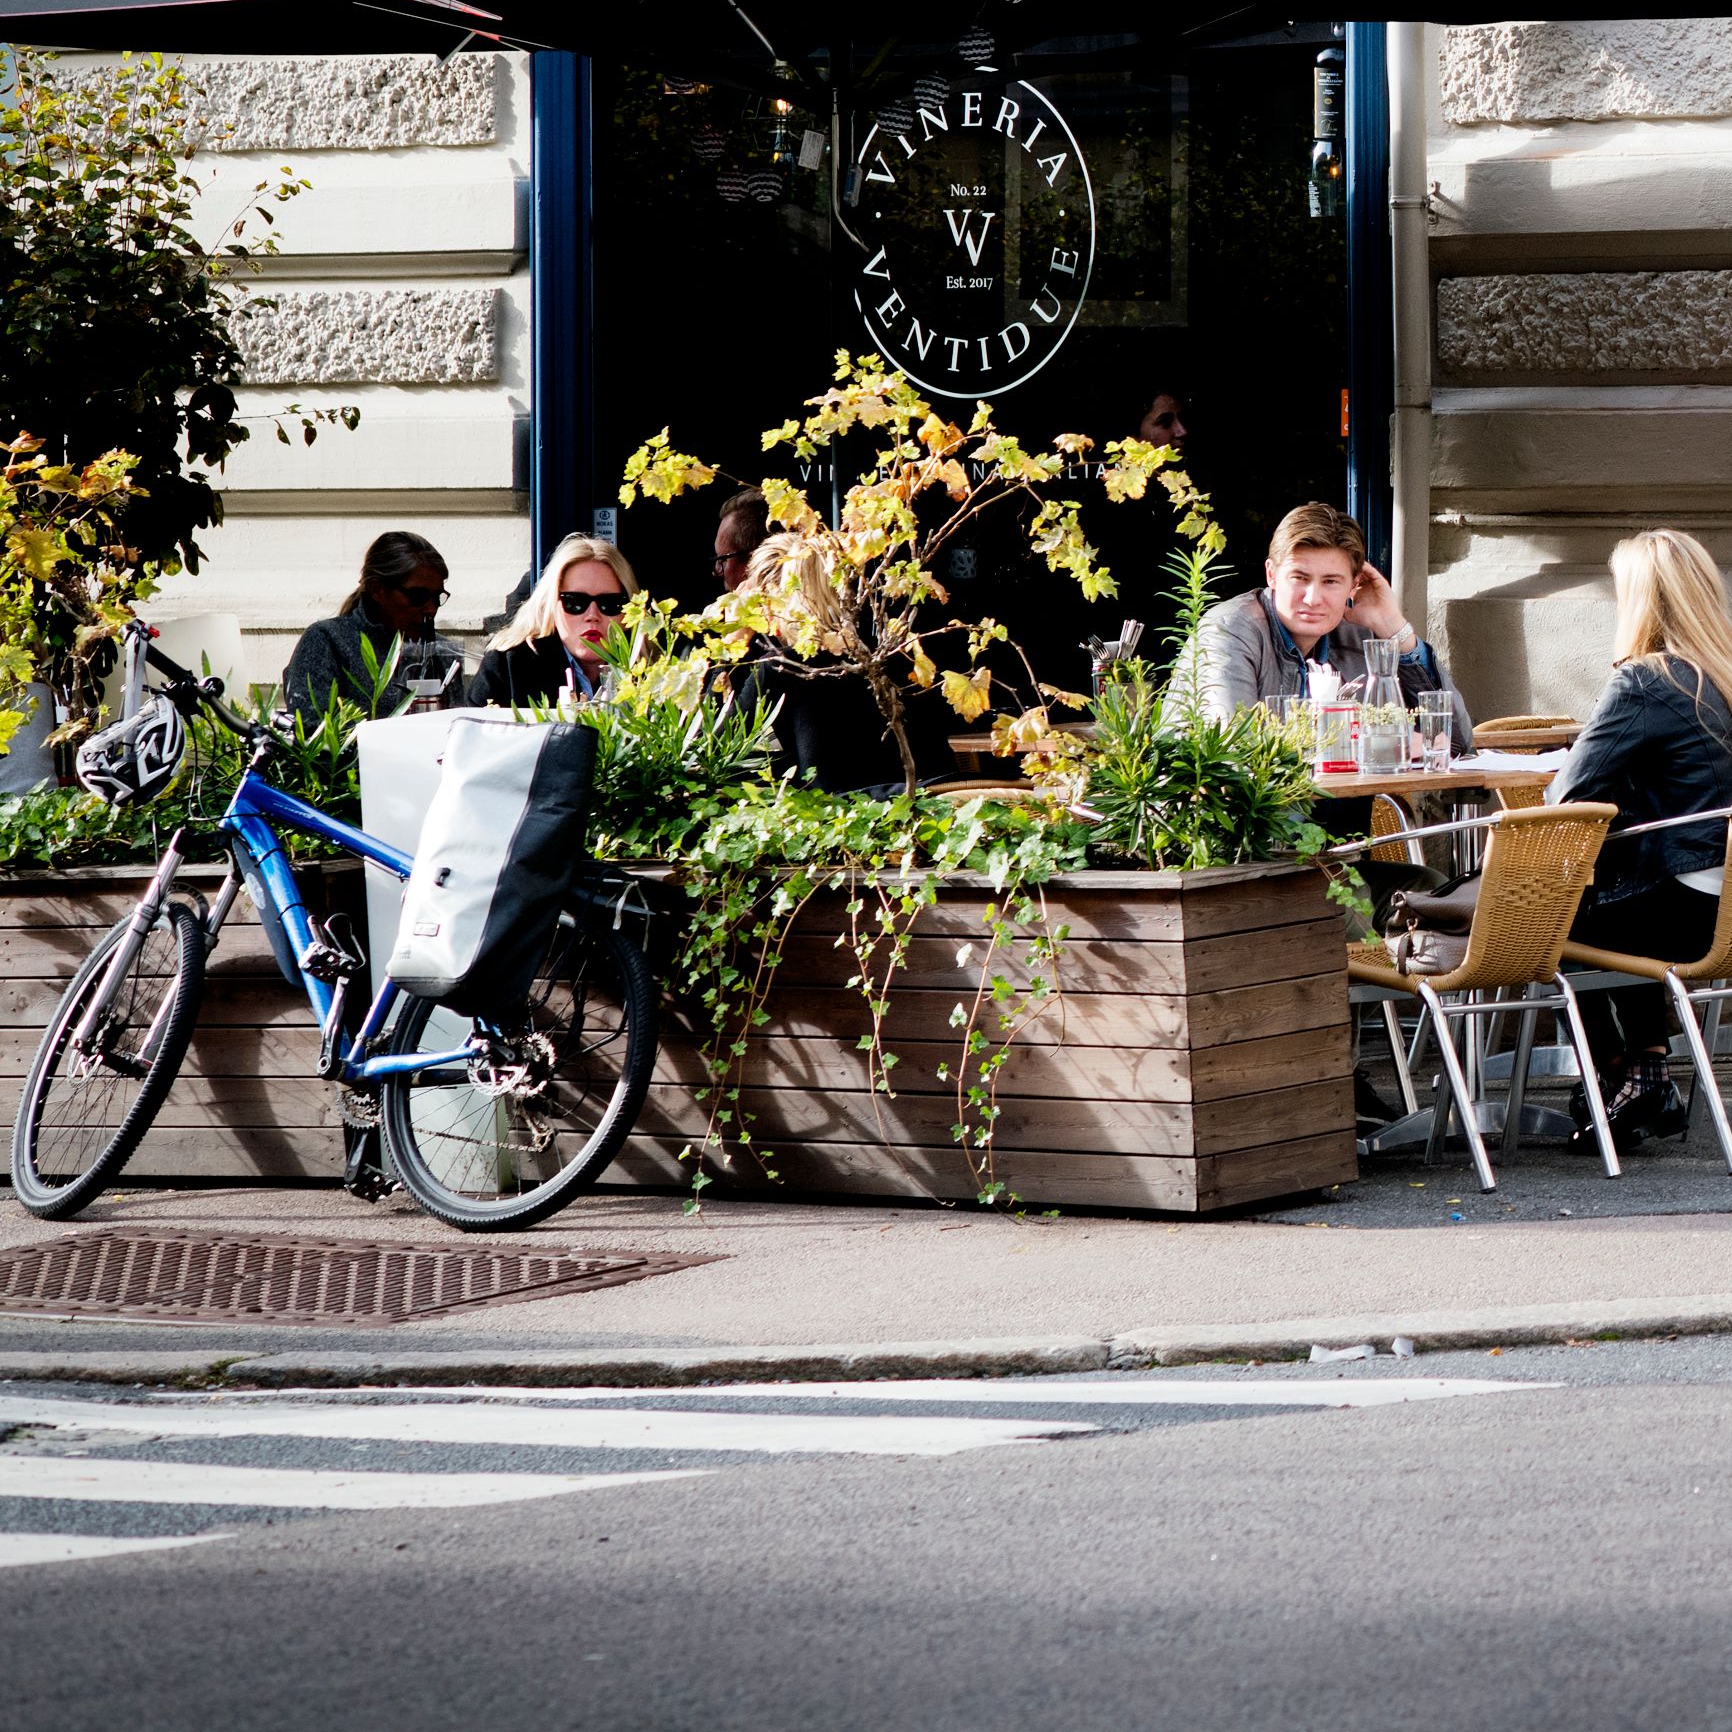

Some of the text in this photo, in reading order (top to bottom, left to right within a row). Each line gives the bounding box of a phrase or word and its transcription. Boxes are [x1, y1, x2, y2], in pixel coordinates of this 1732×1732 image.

[865, 92, 1067, 187] VINERIA
[950, 183, 987, 196] No. 22
[863, 245, 1079, 372] VENTIDUE
[946, 276, 993, 290] Est. 2017
